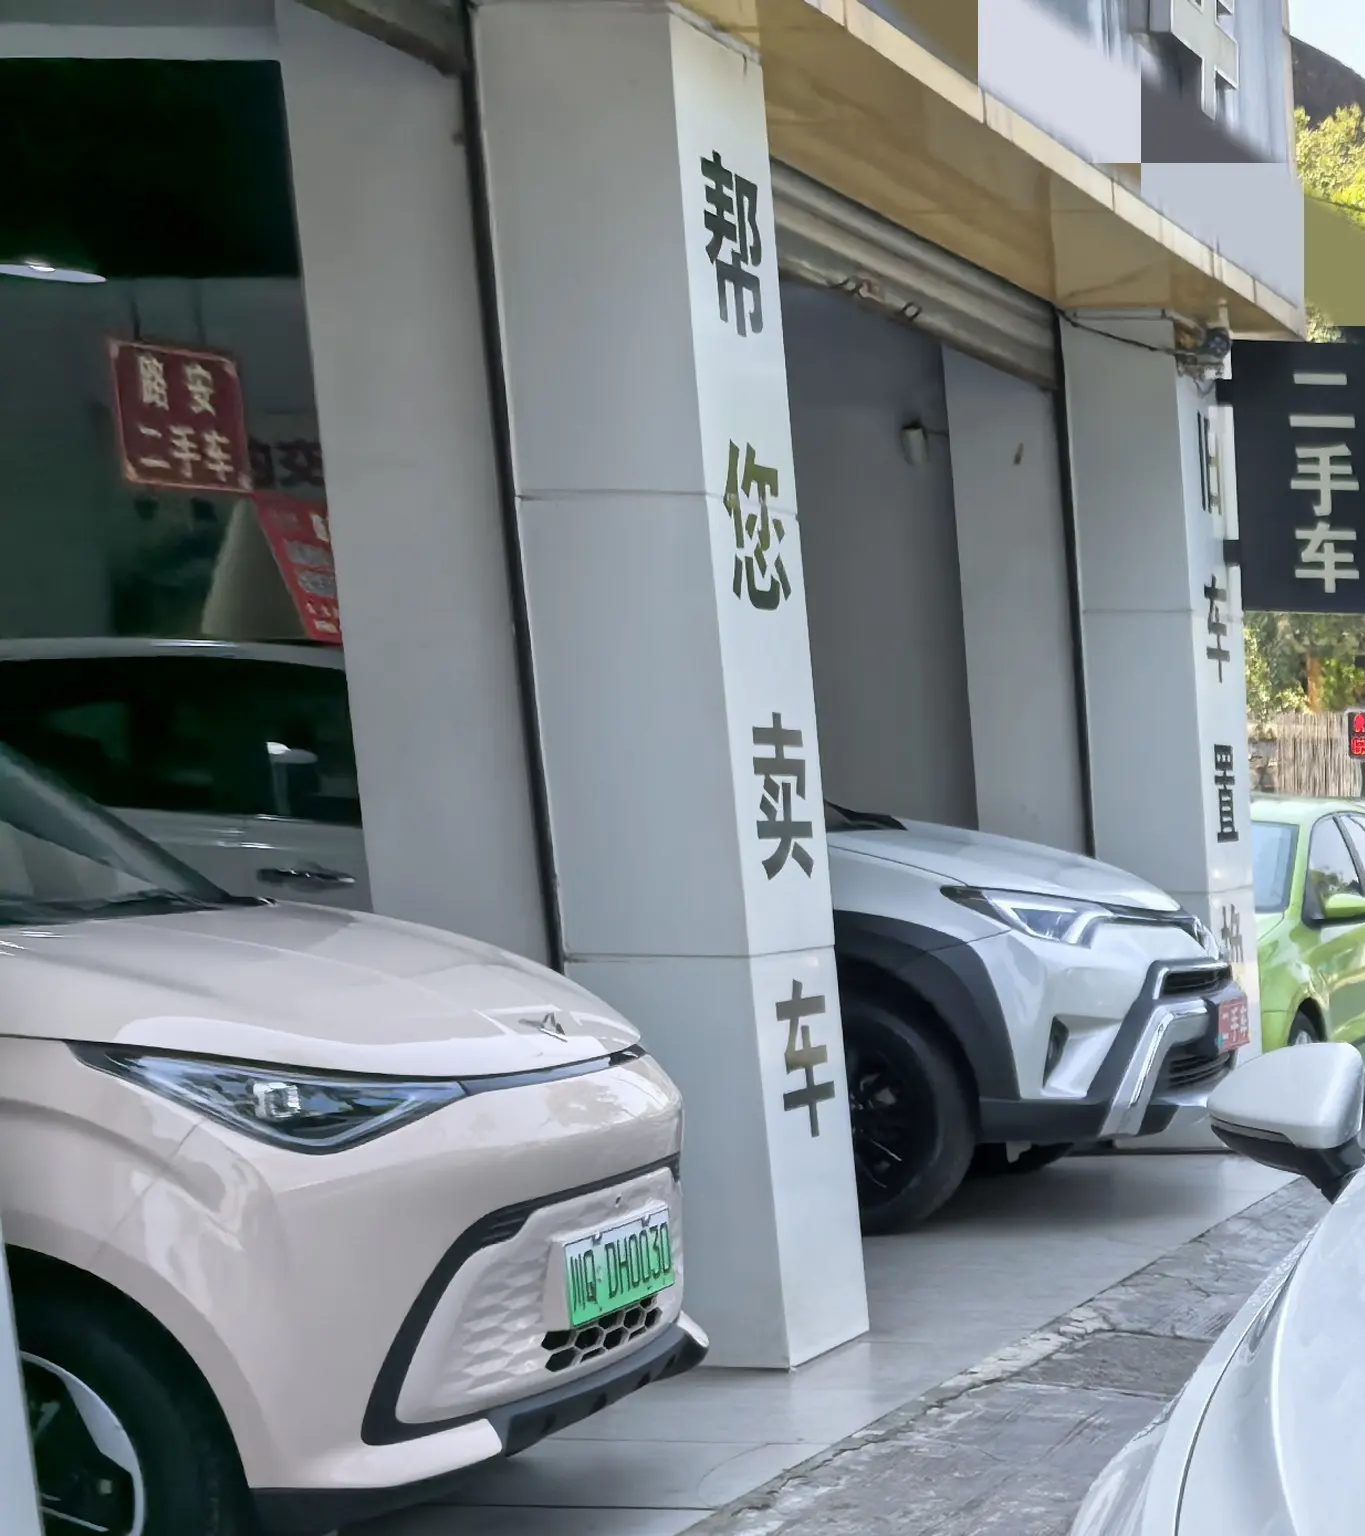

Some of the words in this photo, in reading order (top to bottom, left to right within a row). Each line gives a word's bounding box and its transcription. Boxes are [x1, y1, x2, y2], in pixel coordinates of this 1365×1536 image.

[138, 424, 235, 482] 二手车
[1289, 371, 1360, 594] 二手车
[699, 149, 835, 1138] 帮您卖车
